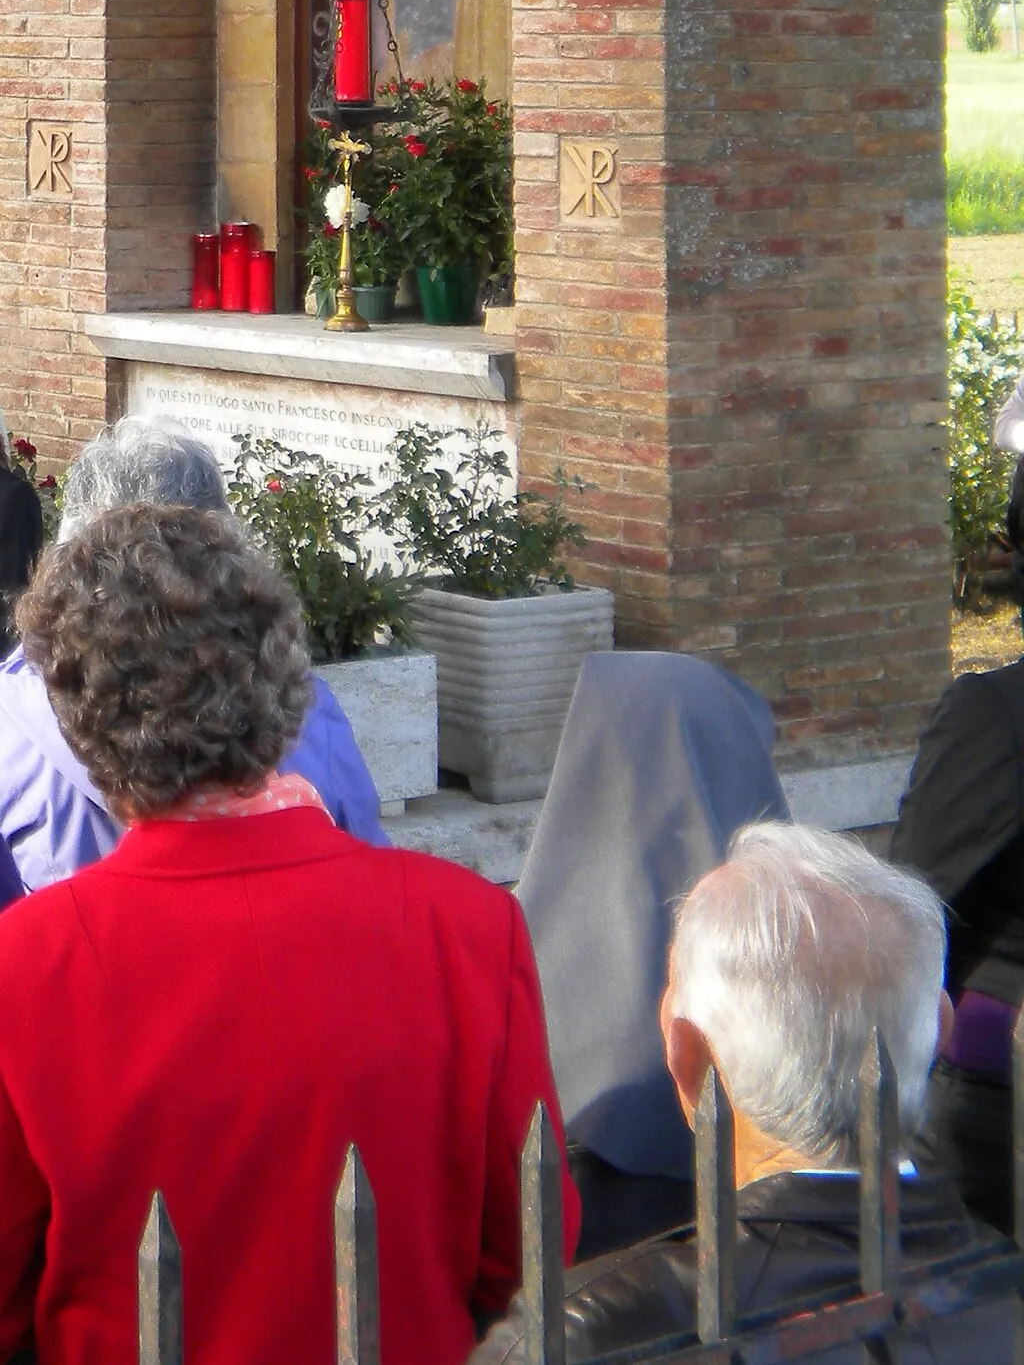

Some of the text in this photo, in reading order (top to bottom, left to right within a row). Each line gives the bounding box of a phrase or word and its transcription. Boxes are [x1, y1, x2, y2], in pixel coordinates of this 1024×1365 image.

[146, 386, 156, 399] IN
[158, 388, 201, 404] QUESTO
[204, 394, 239, 410] LUOGO
[242, 398, 275, 414] SANTO
[278, 399, 347, 423] FRANCESCO
[217, 422, 242, 435] ALLE
[272, 427, 330, 448] SIROCCHIE
